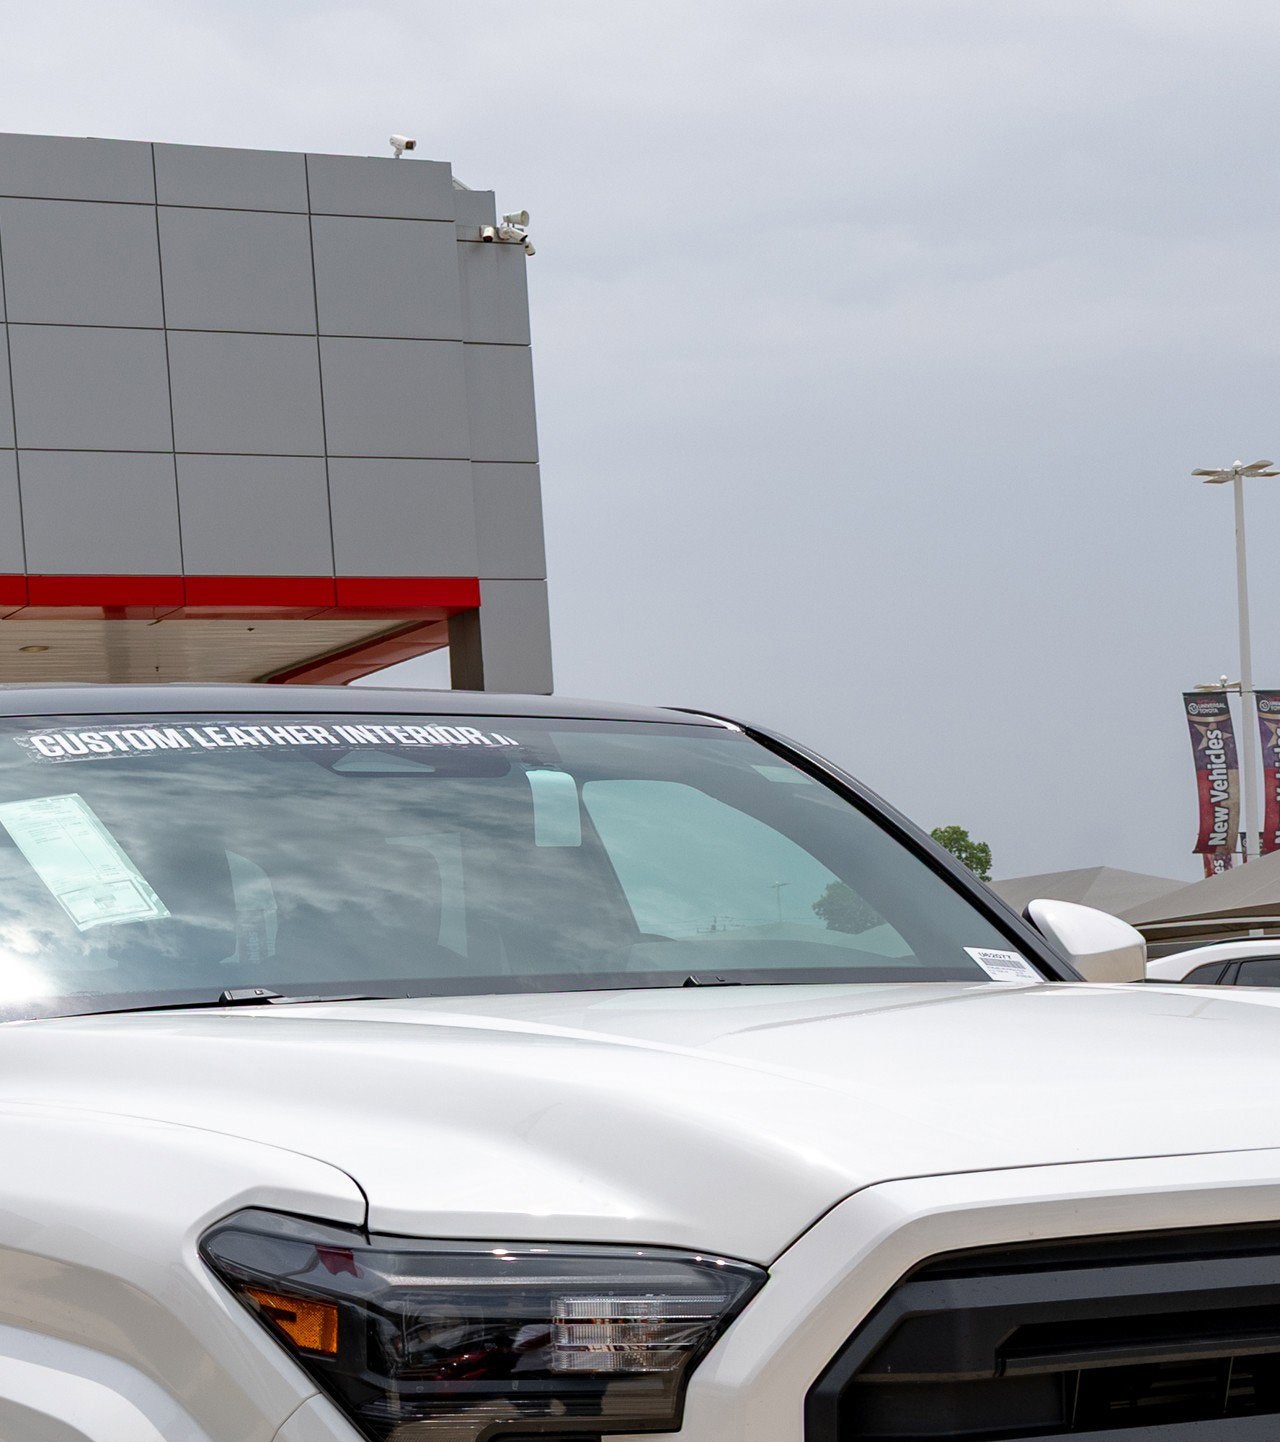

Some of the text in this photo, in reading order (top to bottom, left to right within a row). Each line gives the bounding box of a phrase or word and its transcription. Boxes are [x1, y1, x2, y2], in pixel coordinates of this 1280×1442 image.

[29, 725, 492, 757] CUSTOM LEATHER INTERIOR
[1204, 729, 1230, 803] Vehicles
[1207, 806, 1230, 846] New
